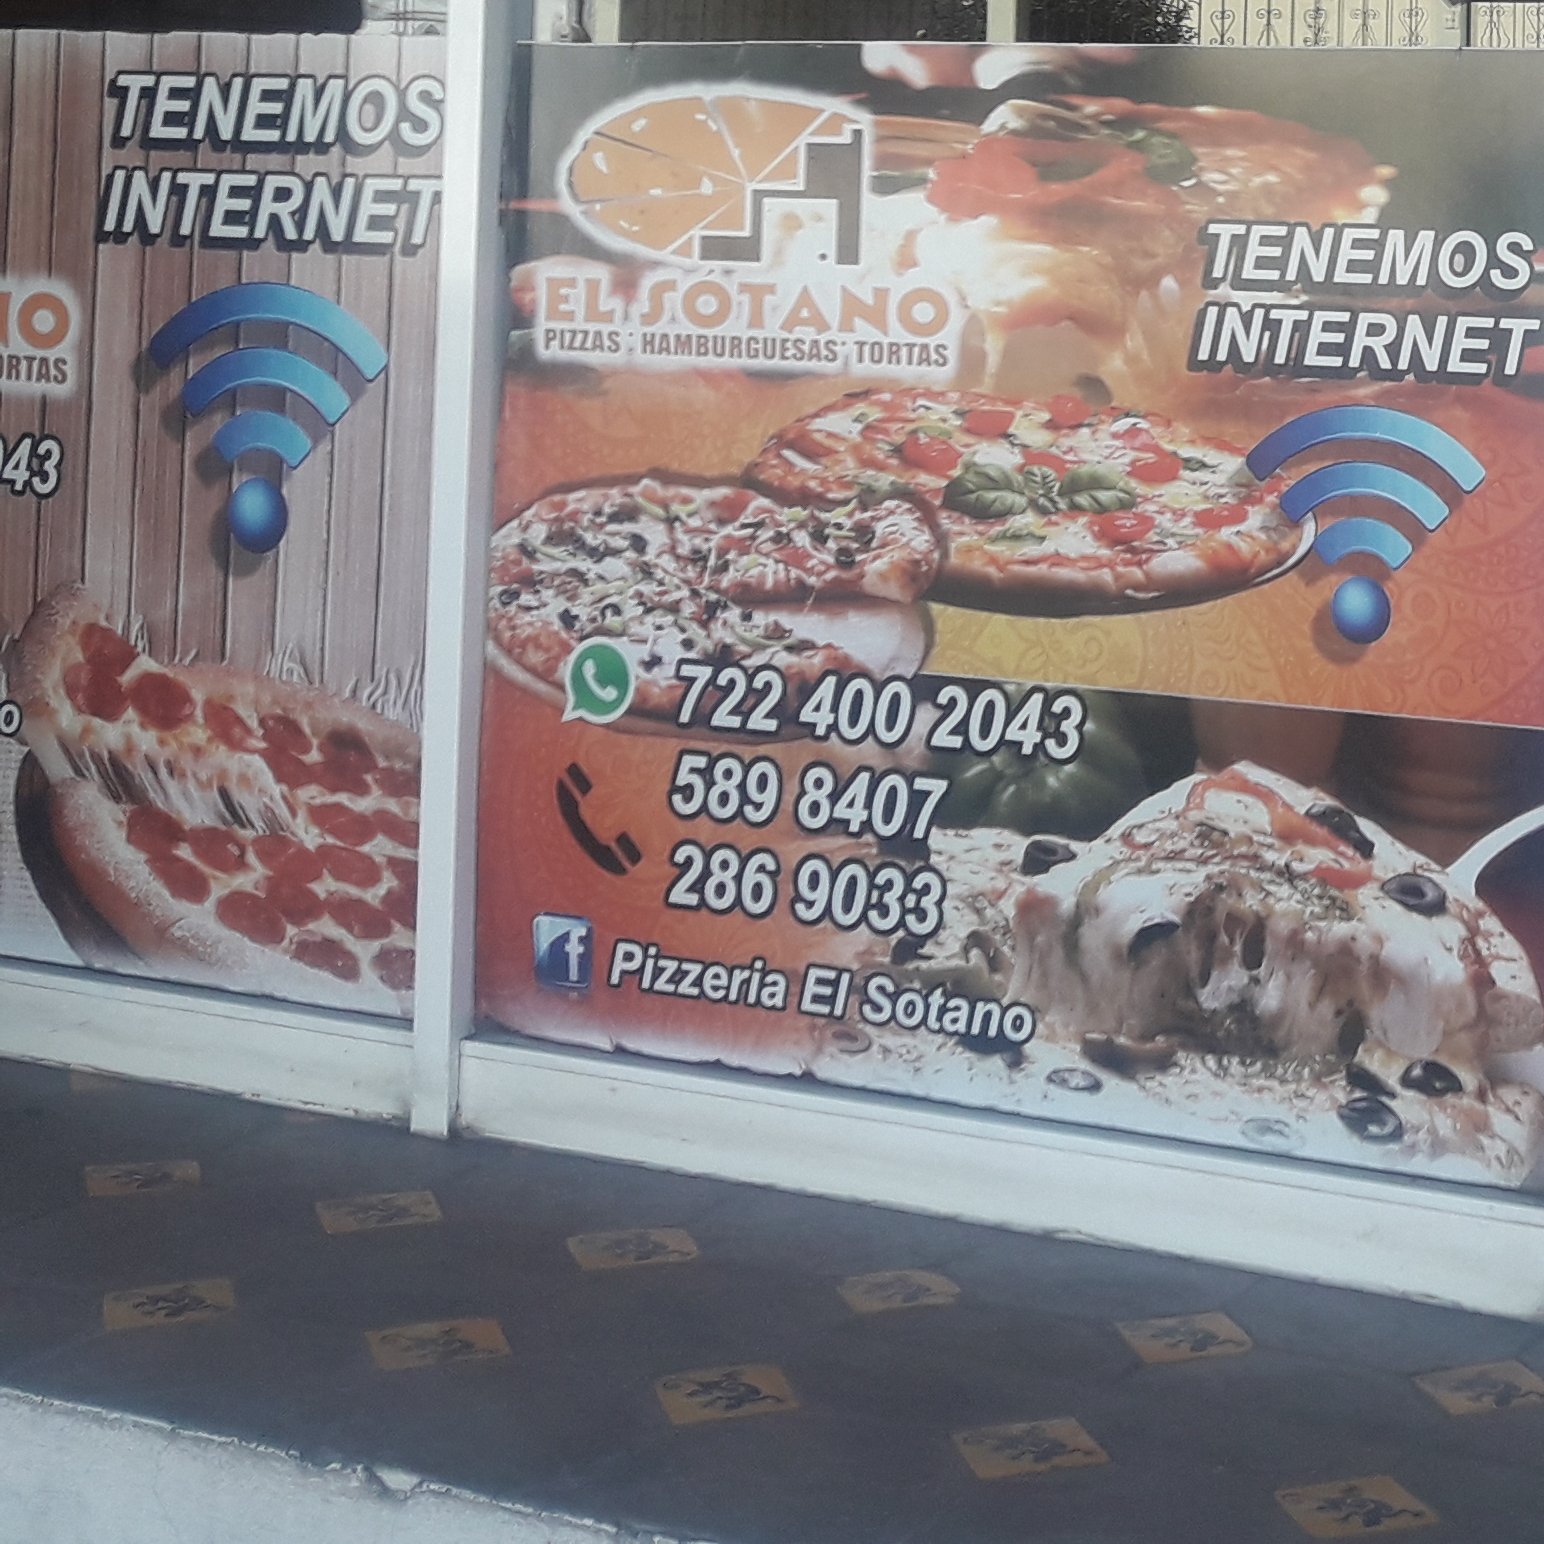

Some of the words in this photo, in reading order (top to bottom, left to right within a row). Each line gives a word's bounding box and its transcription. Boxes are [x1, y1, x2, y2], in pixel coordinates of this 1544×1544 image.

[113, 73, 444, 146] TENEMOS
[103, 168, 443, 246] INTERNET
[1206, 222, 1534, 291] TENEMOS
[545, 277, 614, 324] EL
[0, 354, 68, 385] RTAS
[544, 328, 621, 352] PIZZAS
[641, 332, 839, 364] HAMBURGUESAS
[853, 340, 950, 369] TORTAS
[1196, 304, 1541, 376] INTERNET
[0, 437, 61, 494] 43
[674, 664, 784, 732] 722
[798, 674, 913, 744] 400
[929, 685, 1084, 760] 2043
[670, 753, 781, 825] 589
[796, 765, 947, 839] 8407
[667, 845, 776, 915] 286
[793, 858, 944, 936] 9033
[608, 941, 788, 1009] Pizzeria
[800, 966, 851, 1018] El
[861, 975, 1035, 1043] Sotano
